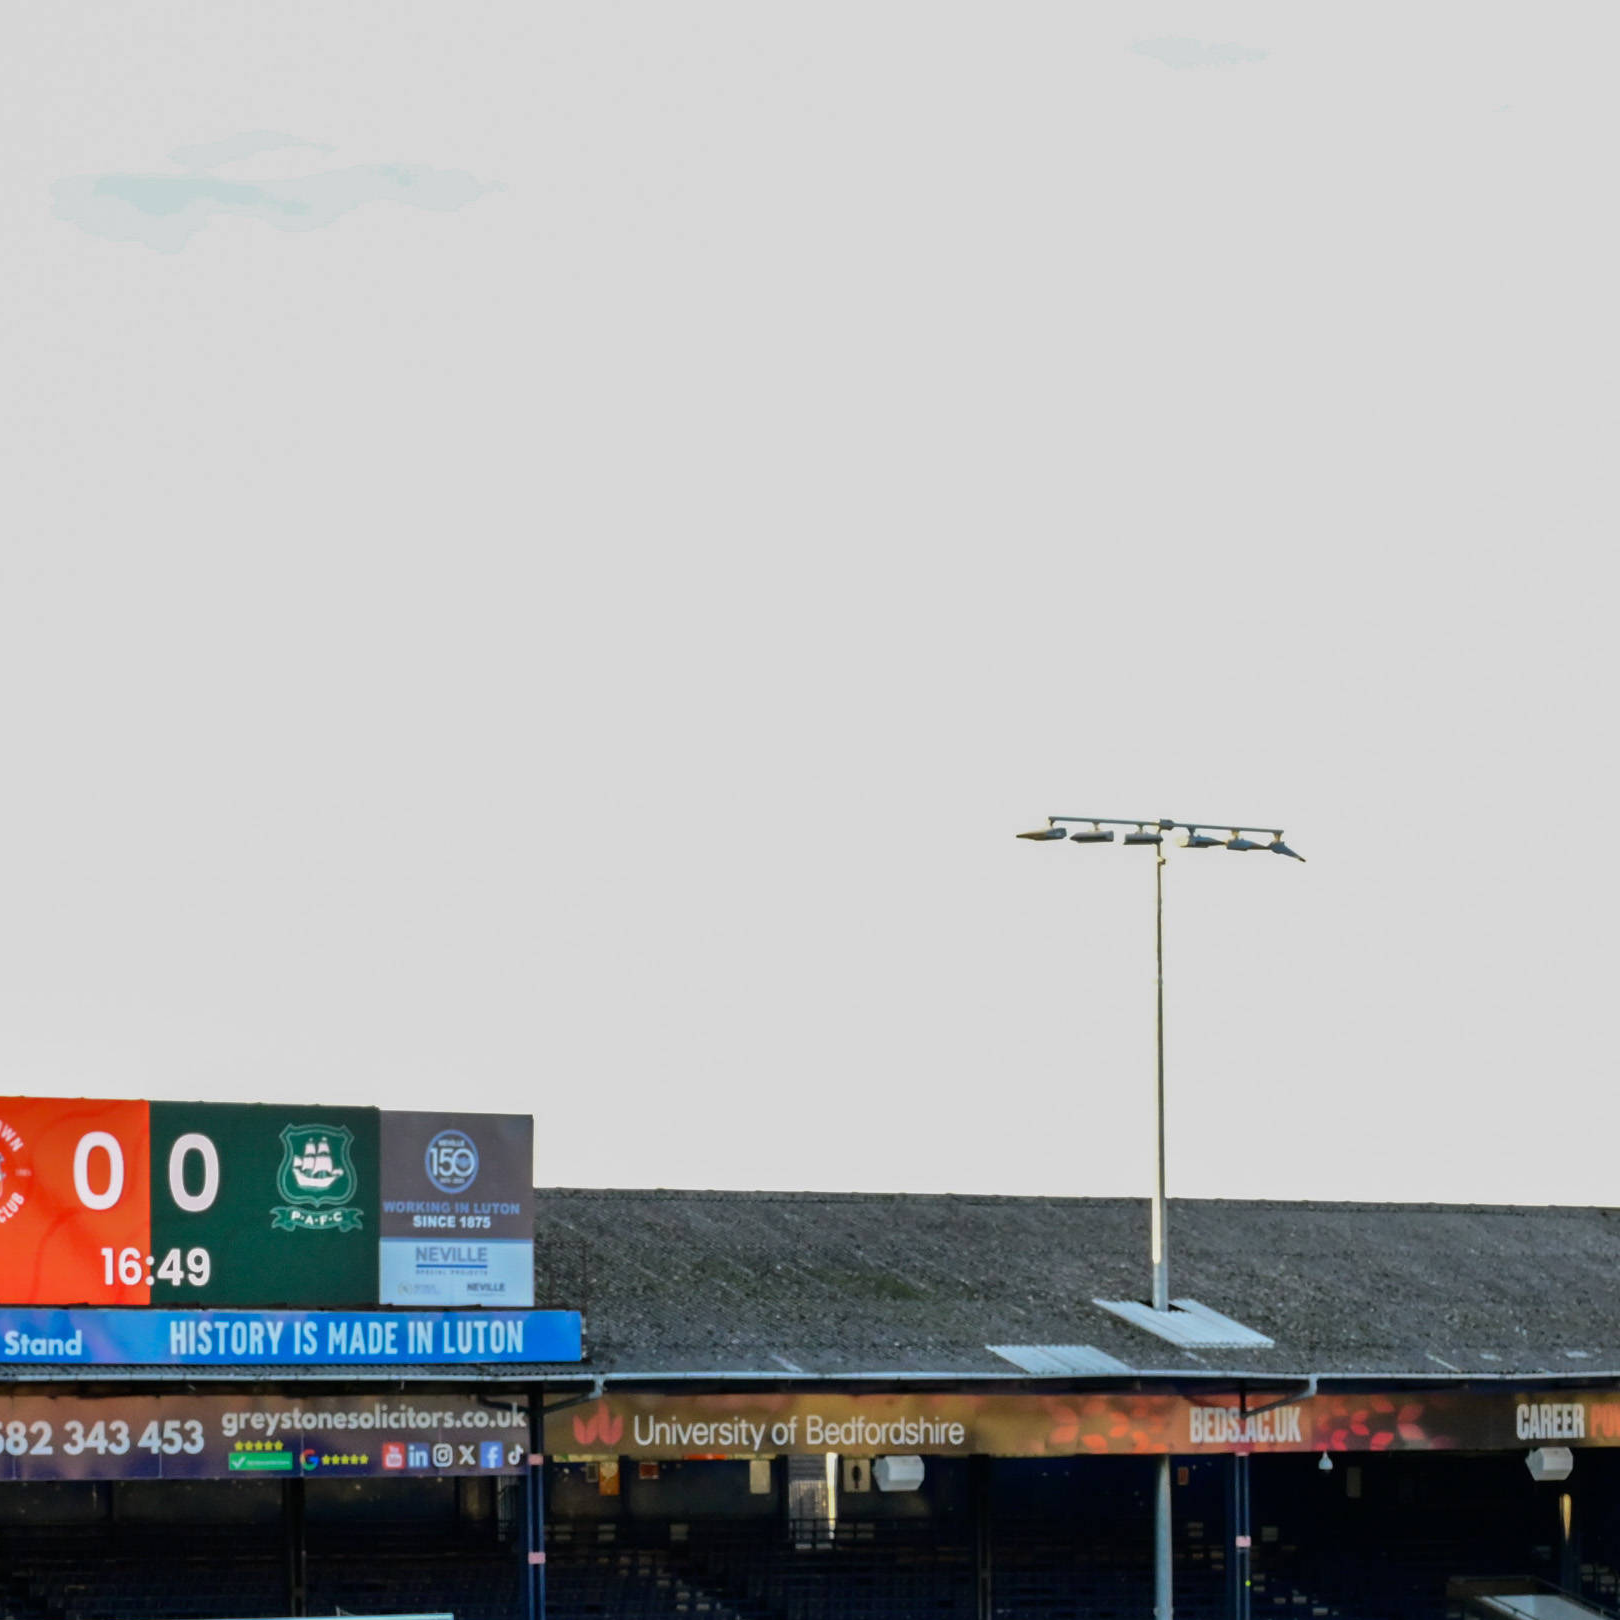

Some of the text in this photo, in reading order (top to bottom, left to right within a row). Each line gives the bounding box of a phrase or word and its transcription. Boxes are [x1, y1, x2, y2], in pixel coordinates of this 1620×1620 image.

[73, 1131, 124, 1210] 0
[169, 1133, 220, 1212] 0
[430, 1148, 475, 1177] 150
[383, 1202, 520, 1215] WORKING IN LUTON
[413, 1216, 491, 1229] SINCE 1875
[100, 1247, 211, 1286] 16:49
[416, 1247, 488, 1262] NEVILLE
[467, 1282, 505, 1292] NEVILLE
[4, 1330, 82, 1356] Stand
[169, 1321, 524, 1355] HISTORY IS MADE IN LUTON
[221, 1402, 527, 1437] greystonesolicitors.co.uk
[633, 1415, 965, 1450] University of Bedfordshire
[1189, 1406, 1302, 1443] BEDS.AC.UK
[1516, 1403, 1585, 1440] CAREER
[63, 1420, 130, 1455] 343
[137, 1420, 205, 1455] 453
